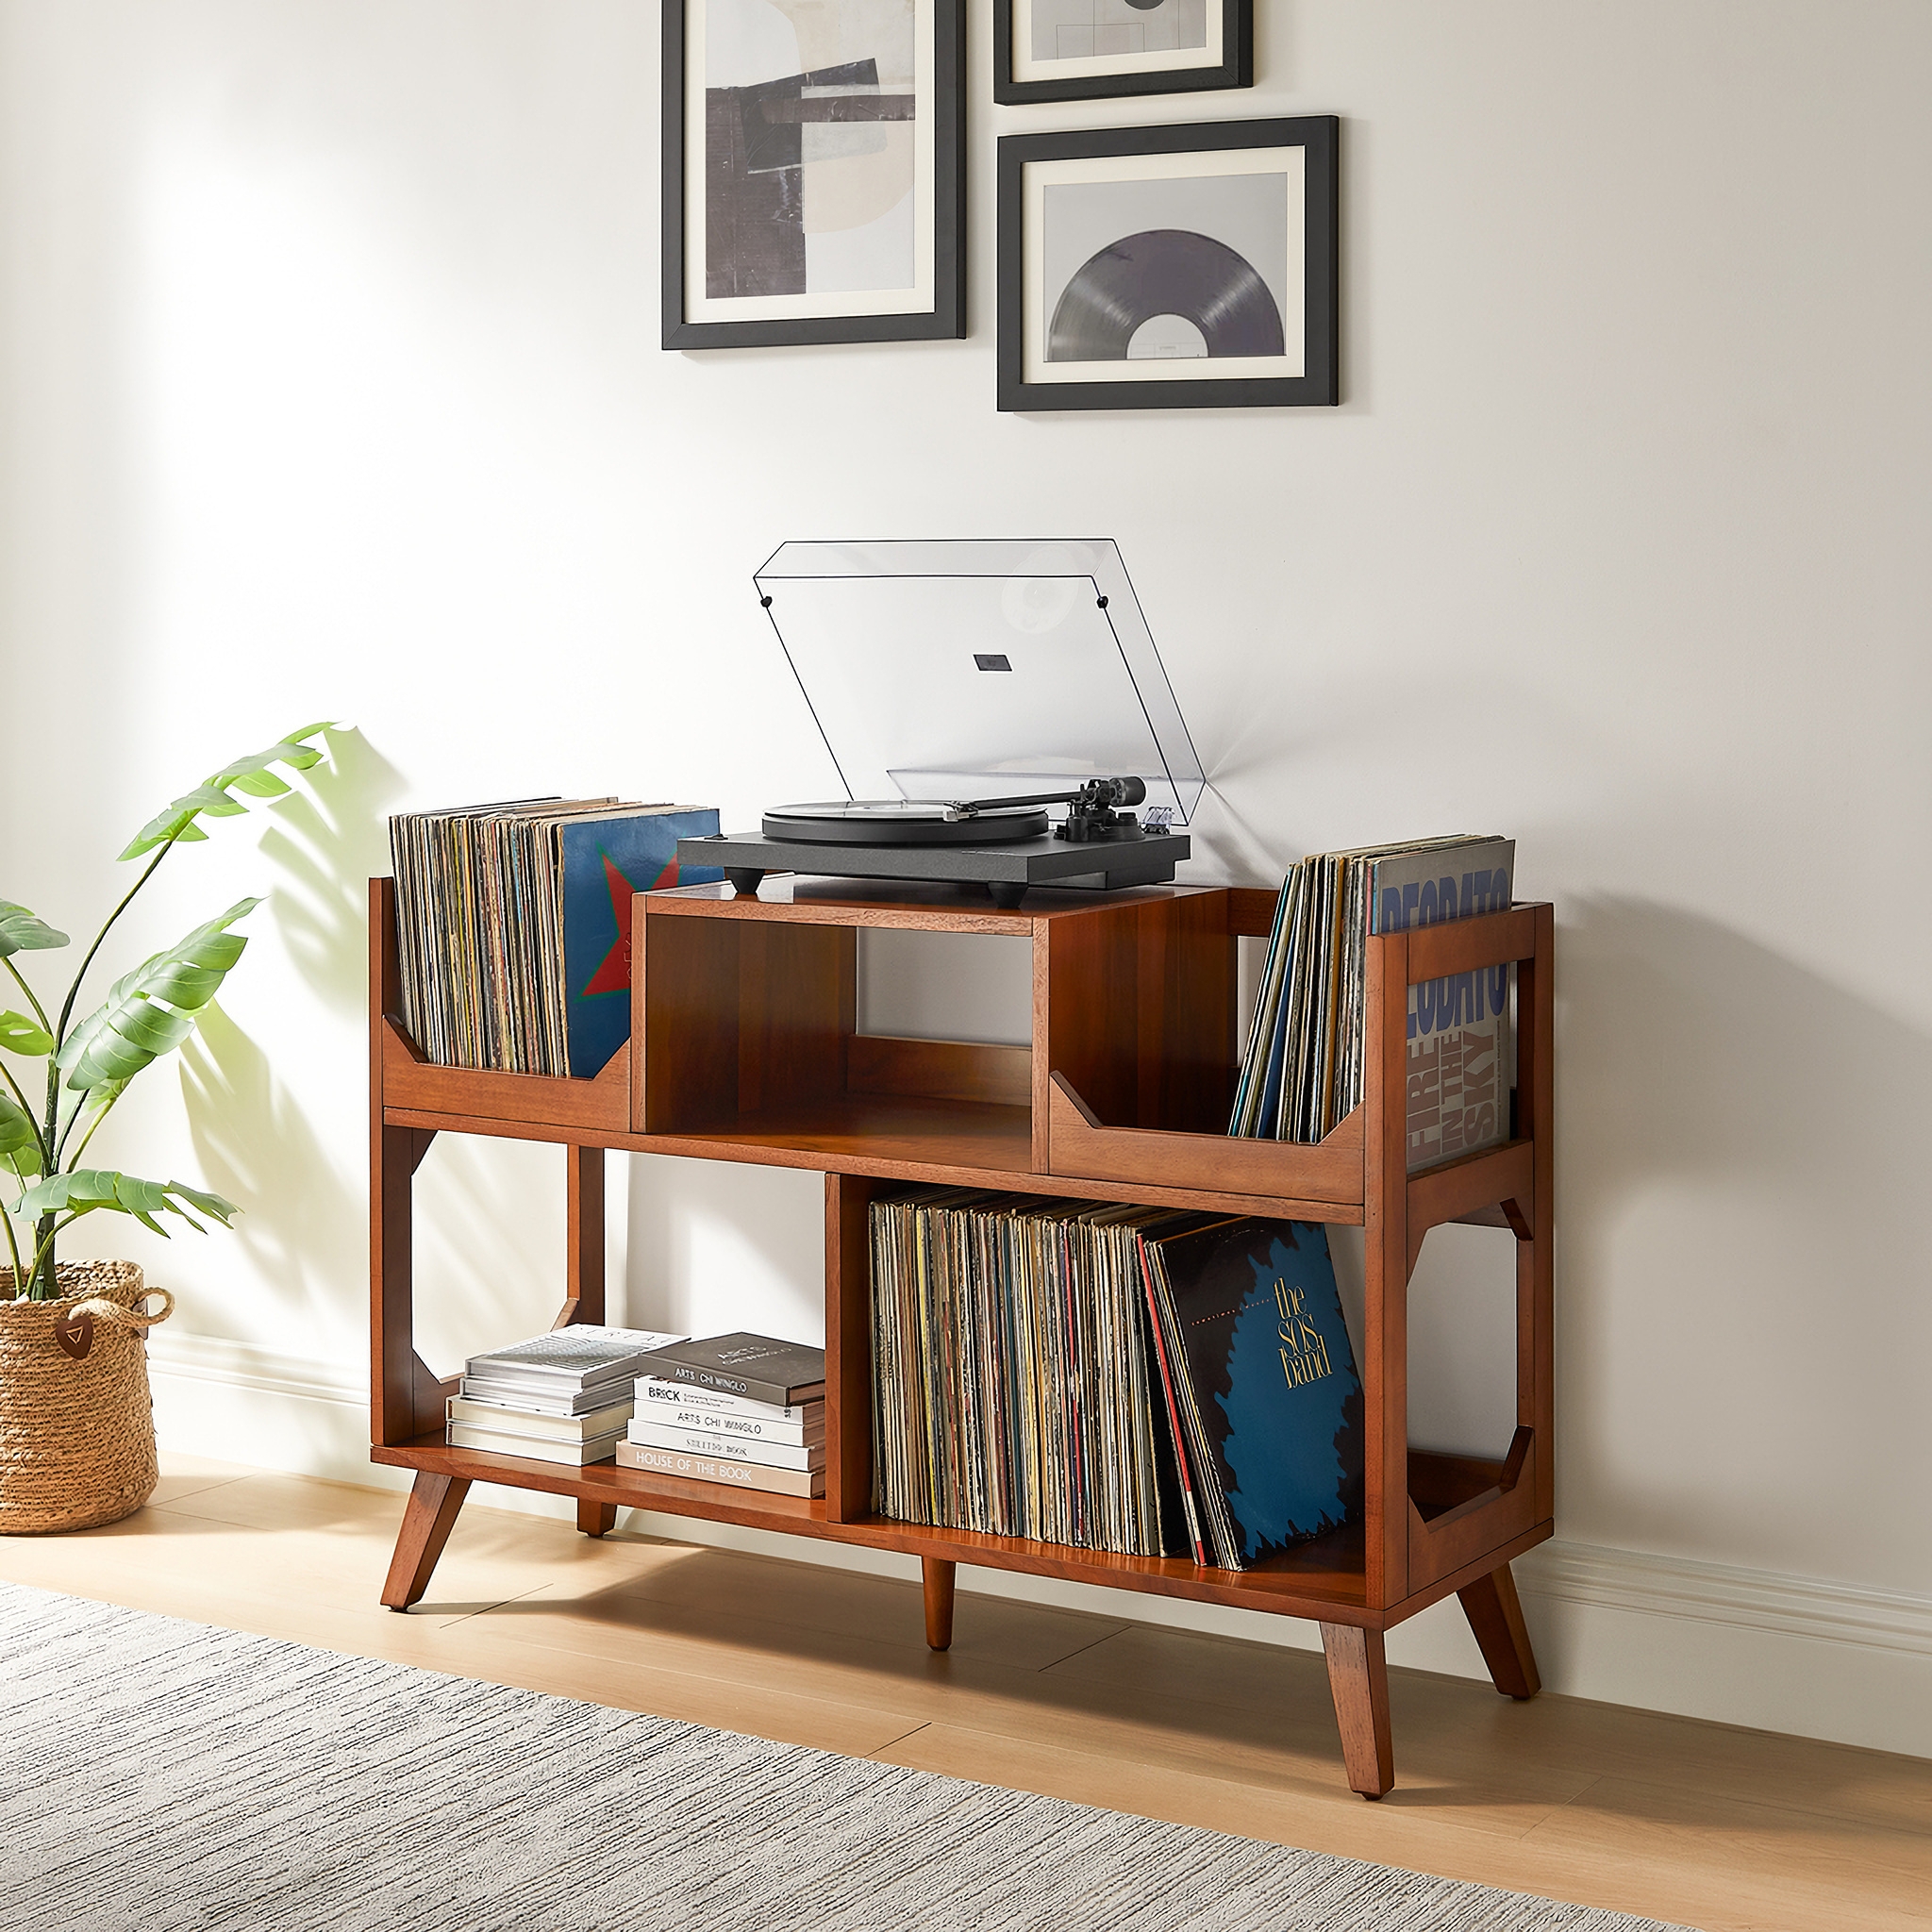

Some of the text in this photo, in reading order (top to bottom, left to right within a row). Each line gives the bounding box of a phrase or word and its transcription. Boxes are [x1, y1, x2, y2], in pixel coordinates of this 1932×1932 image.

[1407, 1037, 1441, 1166] FIRE
[1440, 1030, 1463, 1154] IN THE
[1463, 1030, 1495, 1146] SKY
[1274, 1277, 1307, 1320] the
[675, 1367, 695, 1381] ARTS
[1278, 1335, 1333, 1391] band
[704, 1416, 721, 1427] CHI
[635, 1451, 753, 1482] HOUSE OF THE BOOK
